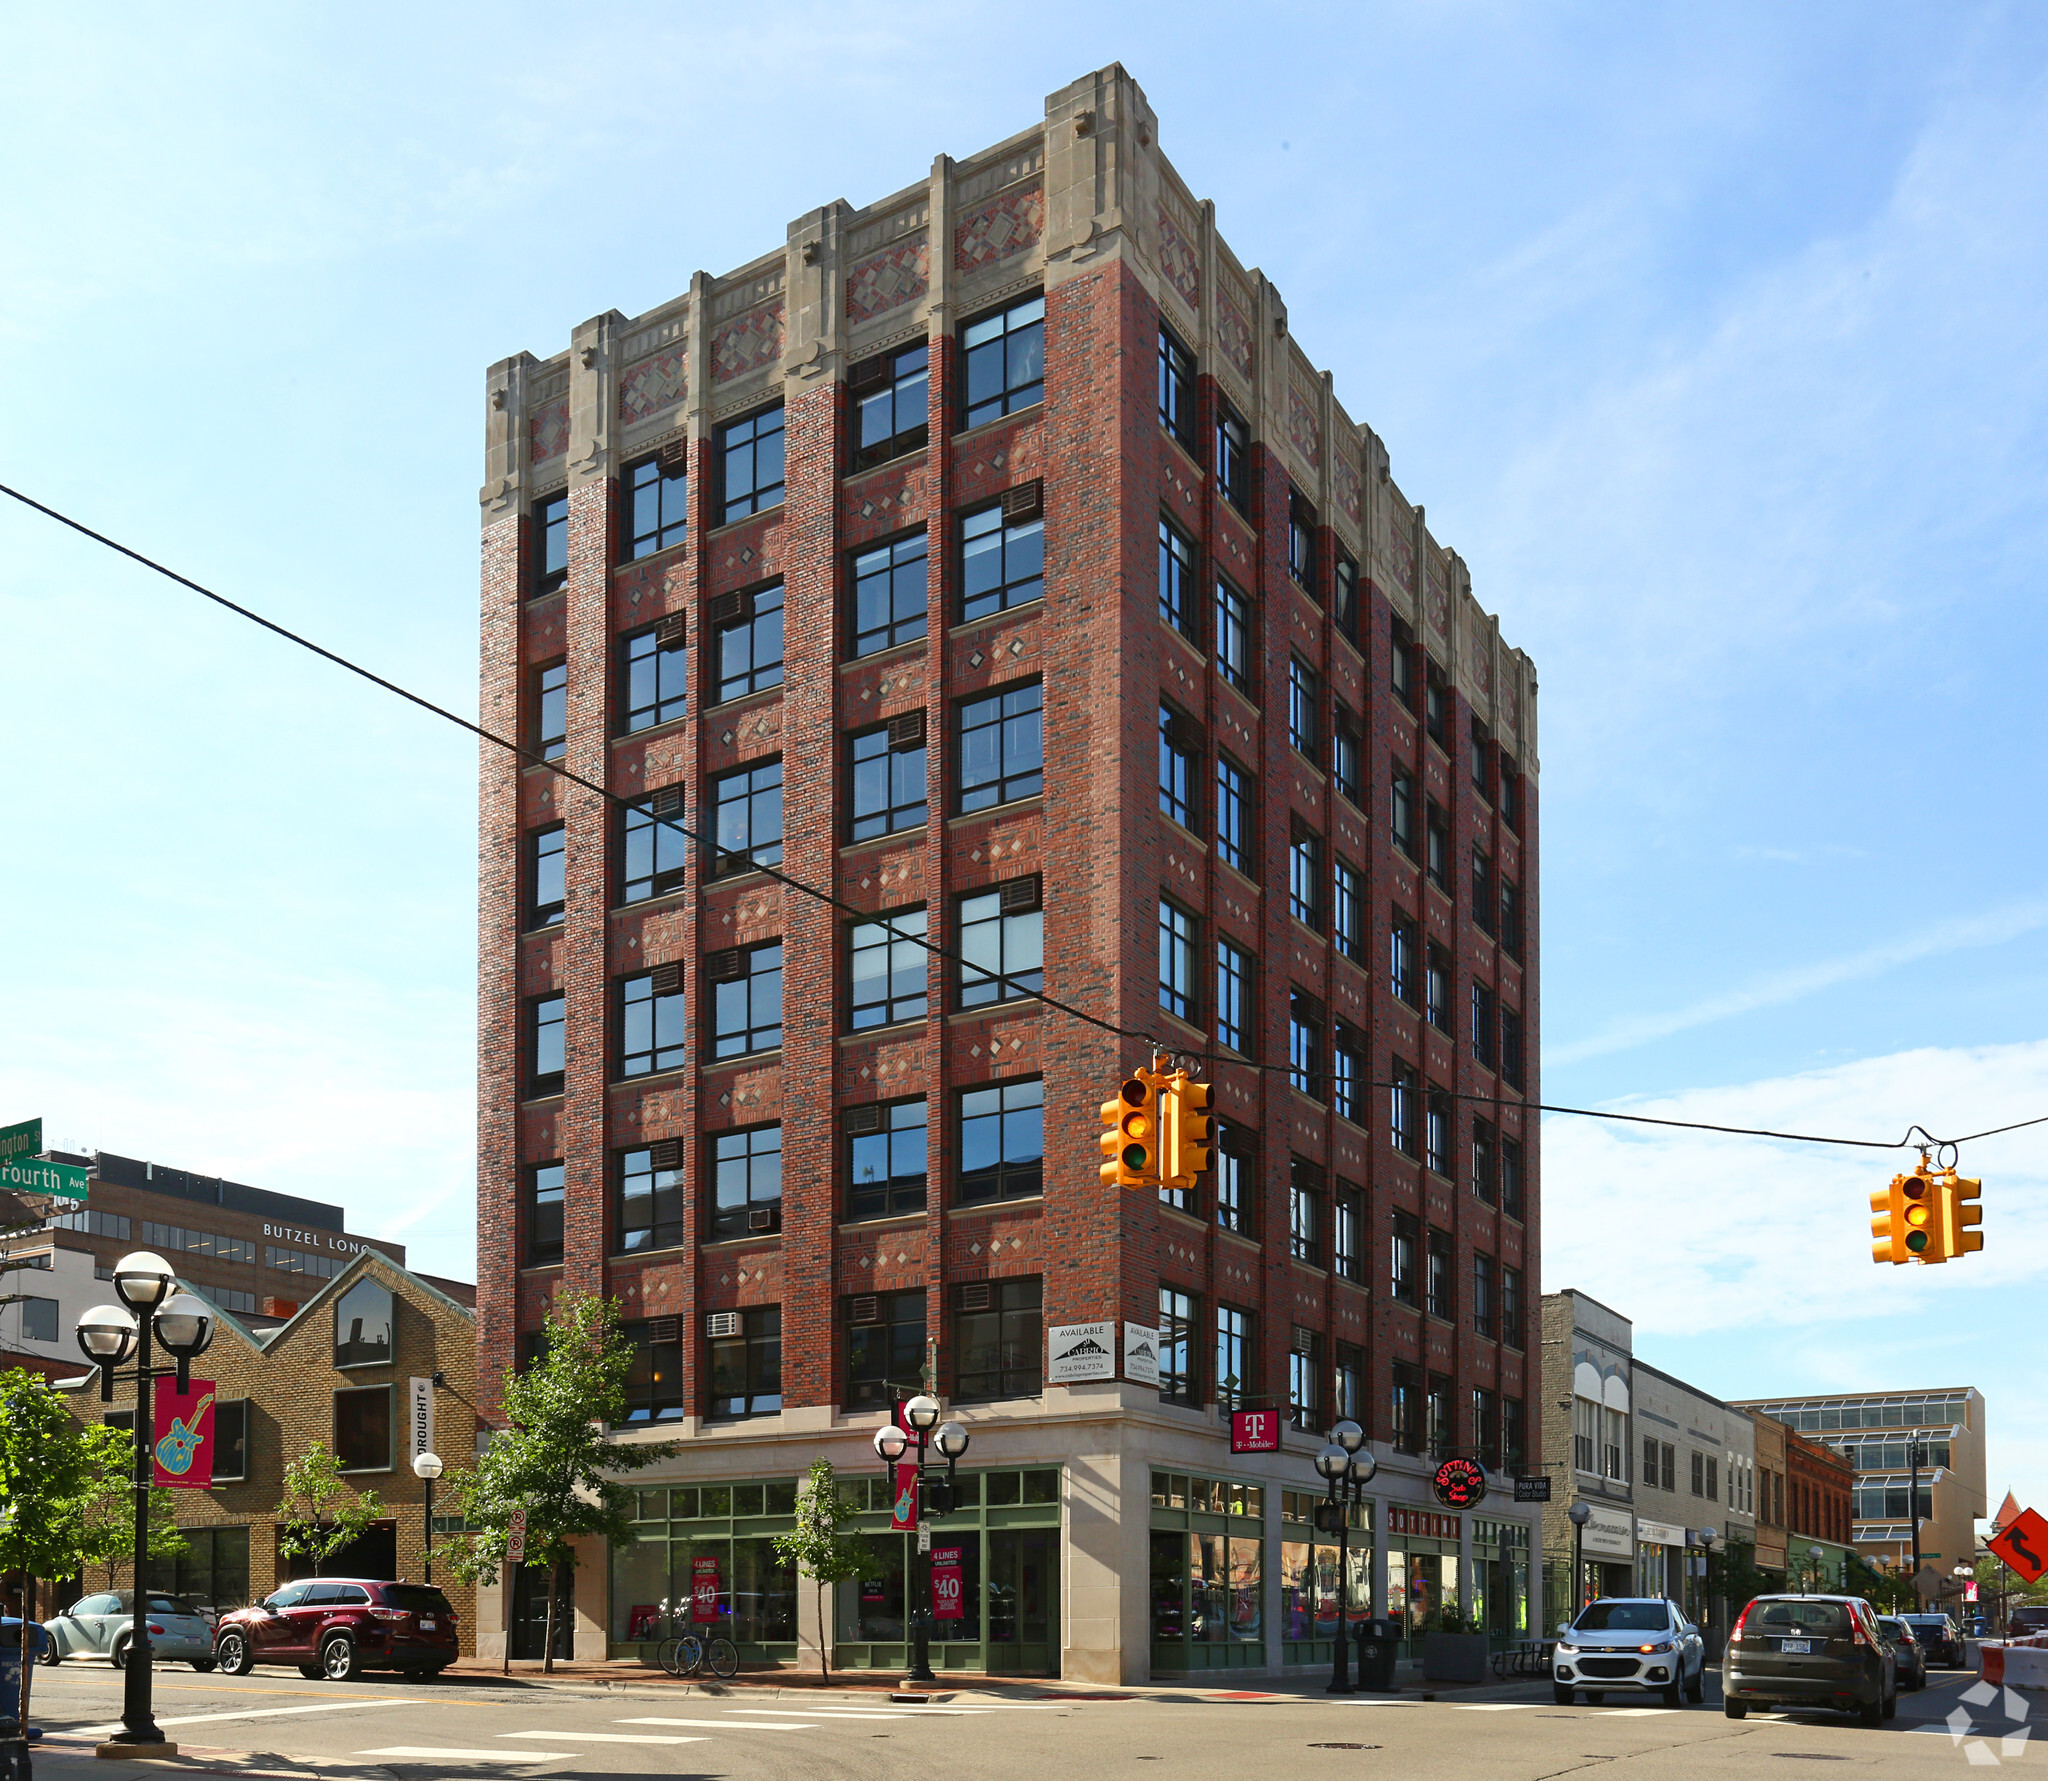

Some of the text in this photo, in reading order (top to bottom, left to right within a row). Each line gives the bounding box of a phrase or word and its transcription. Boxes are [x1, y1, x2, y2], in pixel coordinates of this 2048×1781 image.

[0, 1132, 29, 1161] ington
[69, 1177, 85, 1189] Ave
[263, 1223, 320, 1247] BUTZEL
[1060, 1325, 1104, 1338] AVAILABLE
[1130, 1328, 1155, 1340] AVAILABLE
[1067, 1346, 1104, 1357] CABRIO
[1450, 1483, 1467, 1492] Sub
[1518, 1481, 1547, 1490] PURA VIDA
[1448, 1491, 1469, 1502] Shop
[938, 1551, 958, 1559] LINES
[934, 1578, 959, 1598] $40
